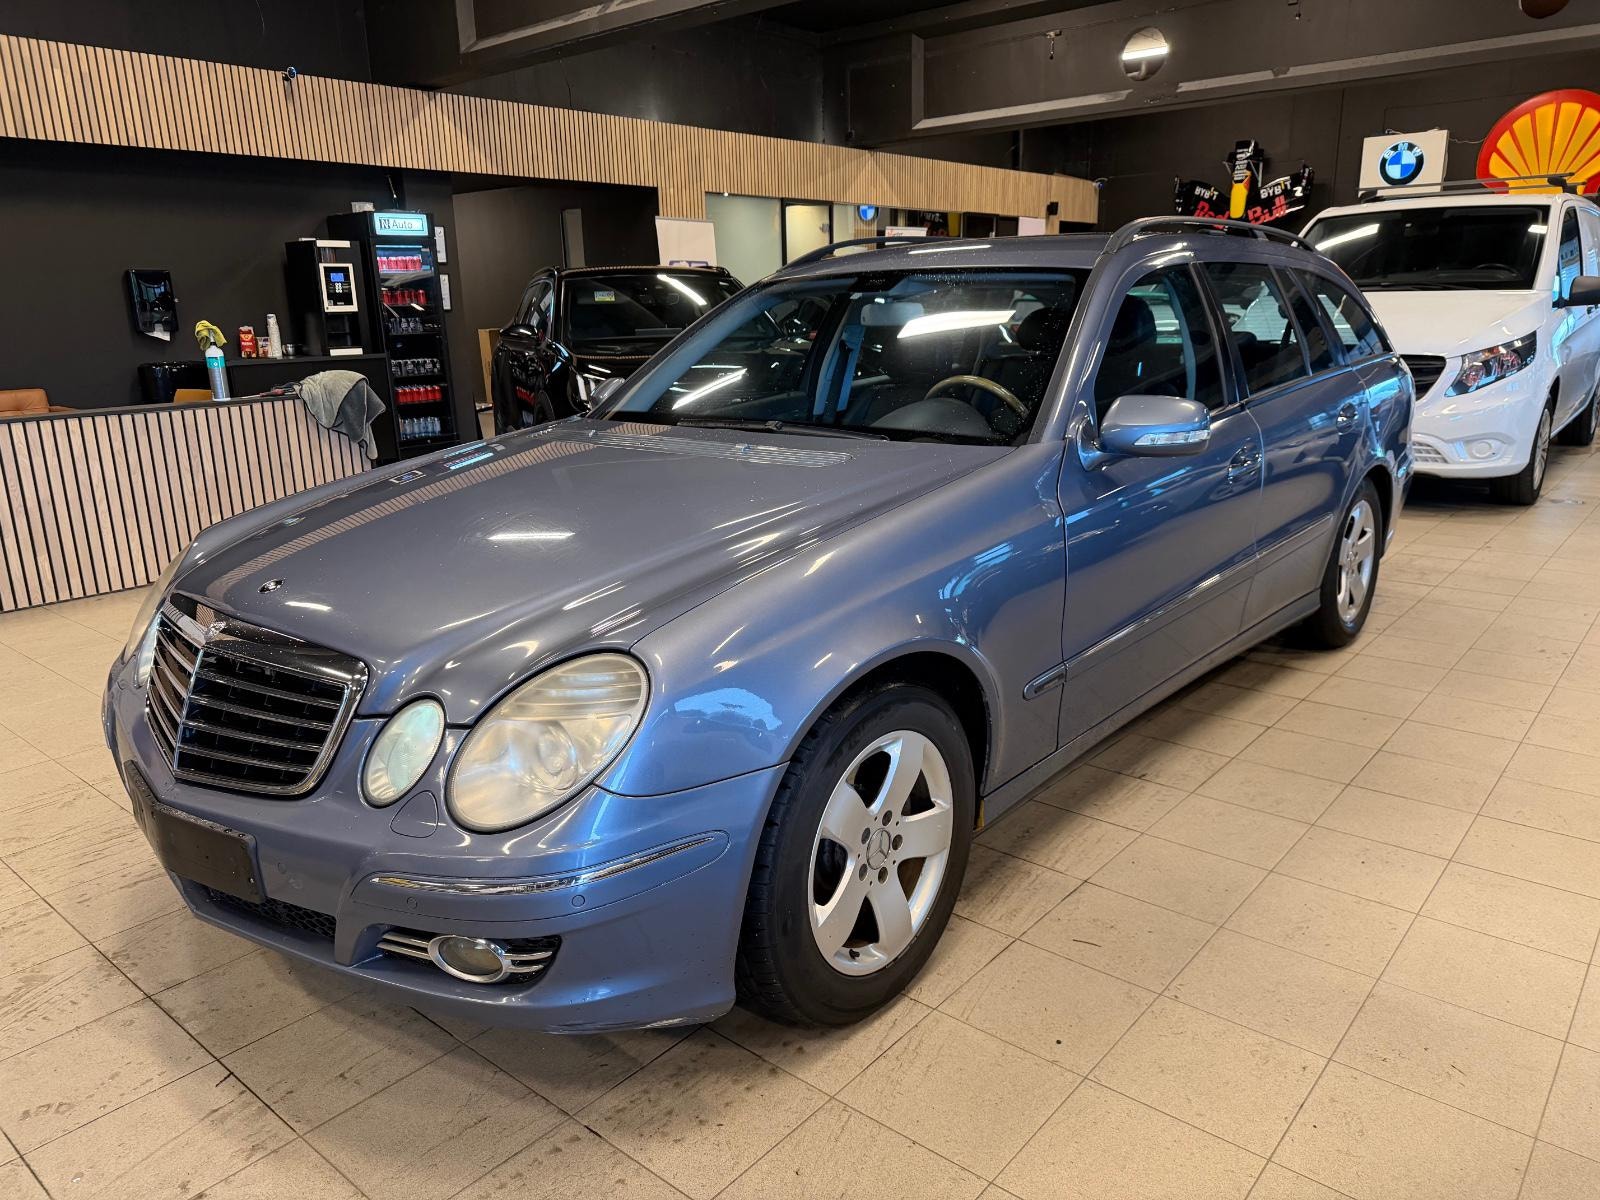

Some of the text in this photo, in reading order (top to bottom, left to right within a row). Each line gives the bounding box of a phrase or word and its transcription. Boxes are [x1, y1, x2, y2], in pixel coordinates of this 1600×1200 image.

[1383, 142, 1423, 160] BMW
[1259, 180, 1292, 199] BYBIT
[1247, 194, 1288, 225] Bull
[392, 219, 413, 230] Auto
